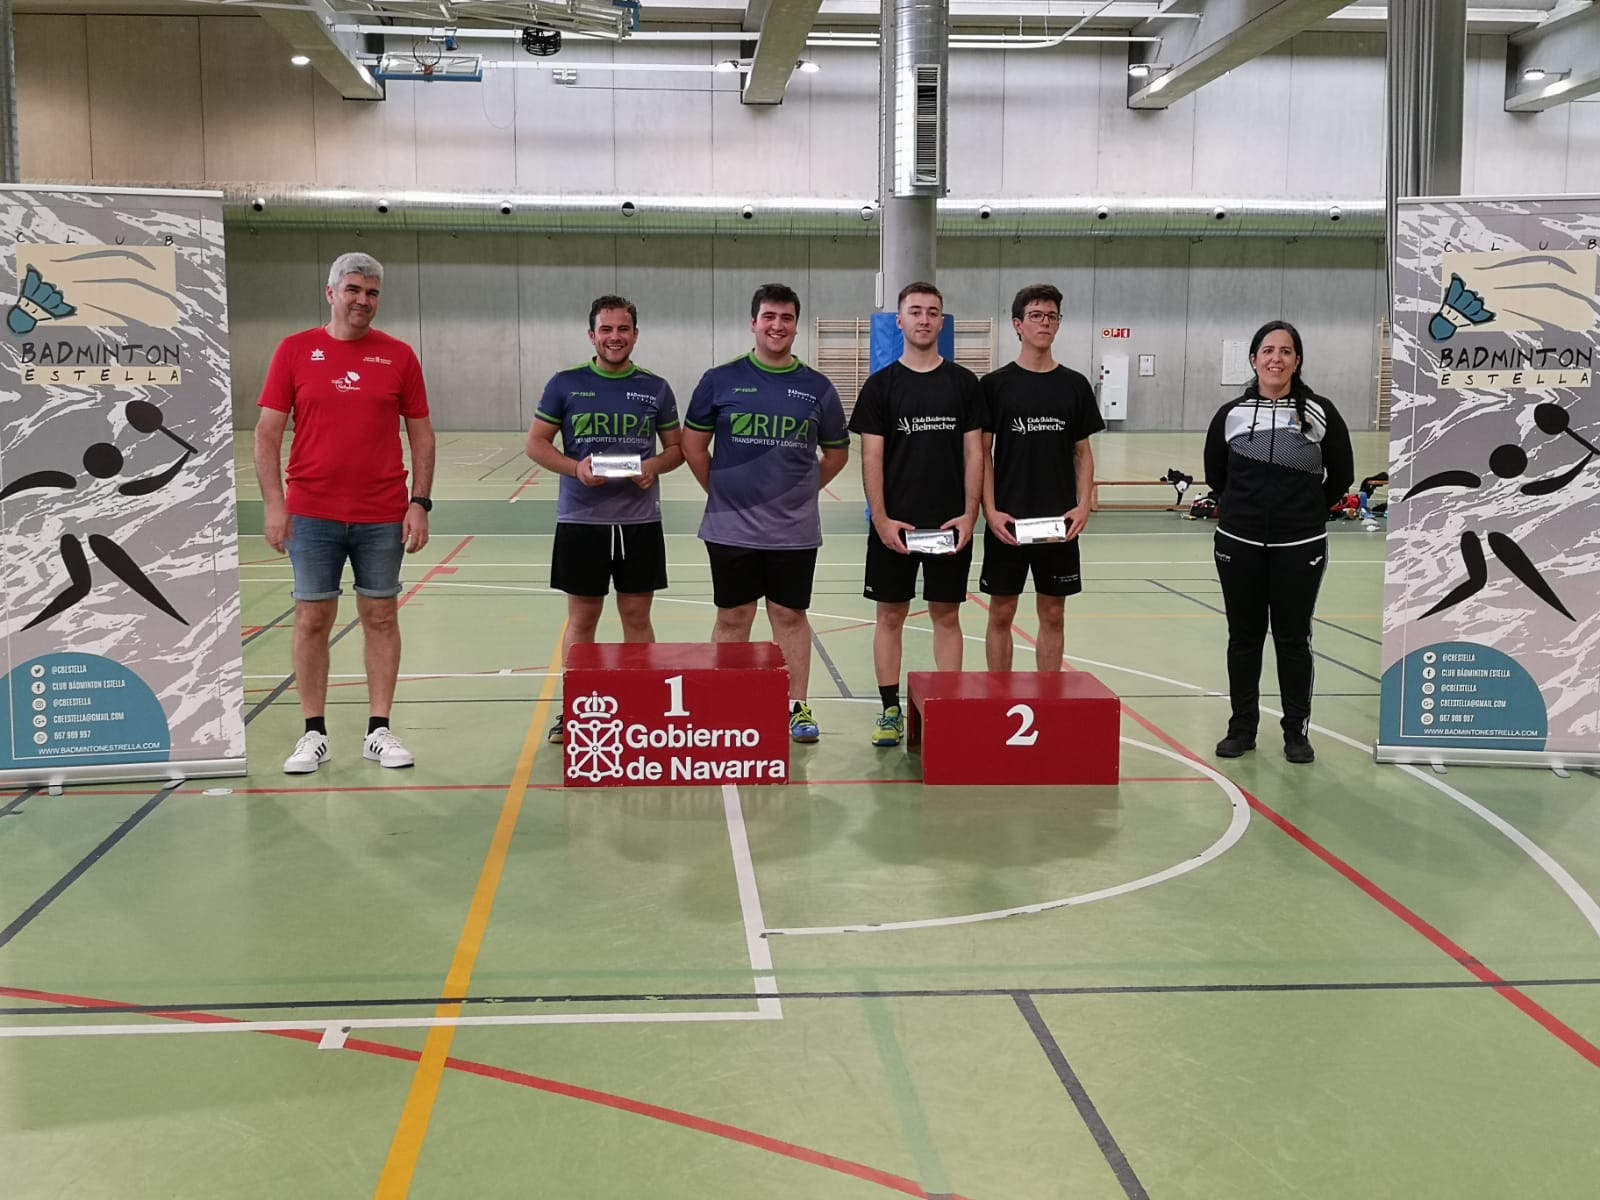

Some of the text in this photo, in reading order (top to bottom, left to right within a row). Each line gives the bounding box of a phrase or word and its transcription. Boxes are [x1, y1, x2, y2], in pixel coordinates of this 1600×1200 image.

[16, 231, 174, 246] CLUB
[1444, 238, 1597, 253] CLUB
[21, 341, 181, 365] BADMINTON
[1439, 346, 1592, 369] BADMINTON
[24, 369, 179, 382] ESTELLA
[1441, 372, 1589, 385] ESTELLA
[594, 412, 650, 437] RIPA
[753, 413, 809, 441] RIPA
[912, 422, 956, 432] Belmecher
[732, 436, 775, 446] TRANSPORTES
[1441, 668, 1456, 677] CLUB
[1489, 668, 1511, 678] ESTELLA
[52, 682, 67, 691] CLUB
[103, 679, 126, 689] ESTELLA
[663, 674, 690, 717] 1
[1005, 703, 1040, 746] 2
[625, 723, 760, 748] Gobierno
[626, 756, 786, 781] de Navarra
